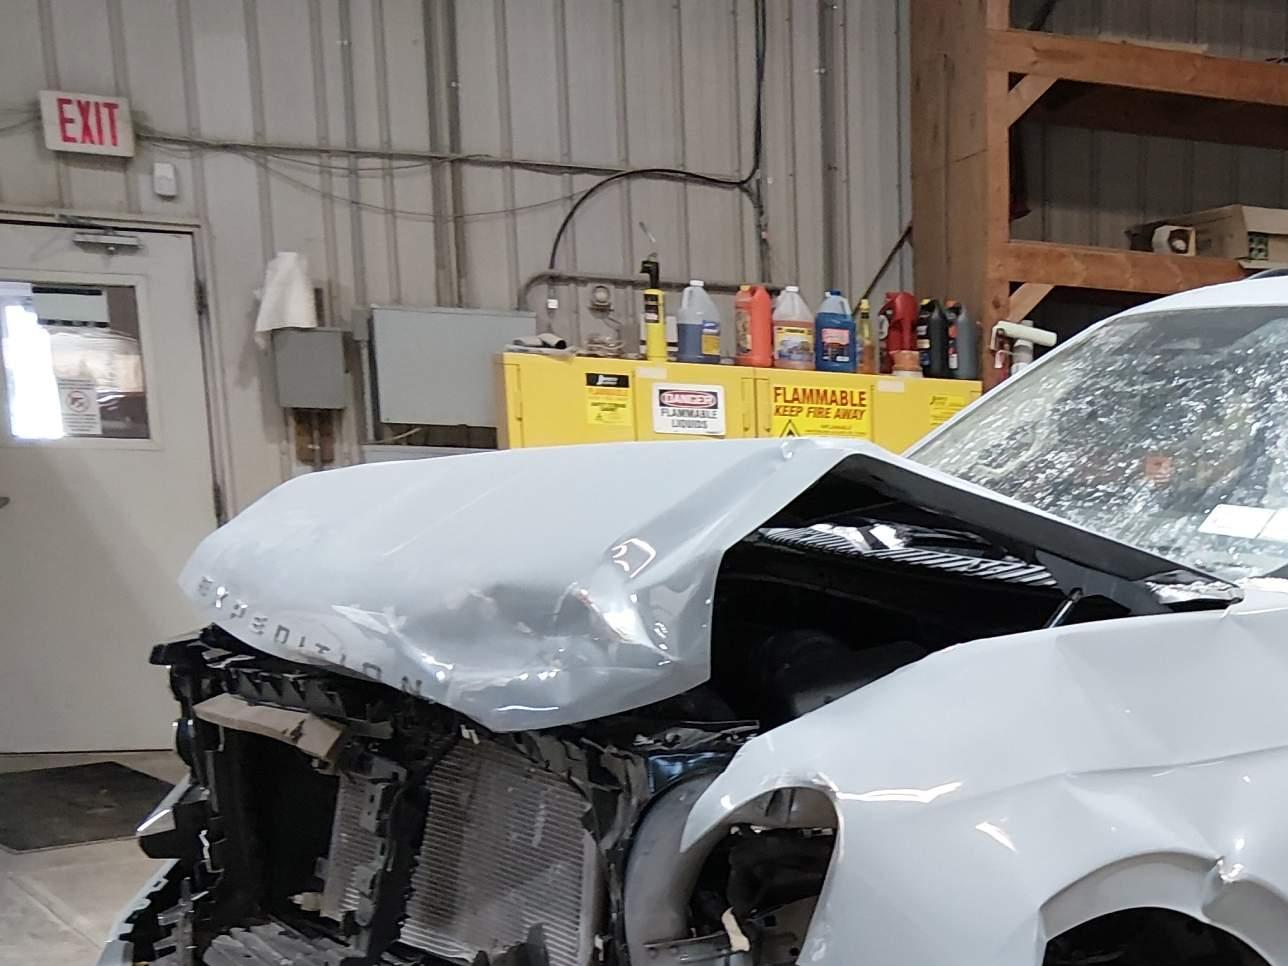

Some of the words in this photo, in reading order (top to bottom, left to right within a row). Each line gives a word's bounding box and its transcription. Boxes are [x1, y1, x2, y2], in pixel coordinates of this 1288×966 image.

[57, 98, 119, 146] EXIT
[773, 387, 867, 407] FLAMMABLE
[660, 408, 719, 419] FLAMMABLE
[774, 405, 803, 417] KEEP
[806, 407, 831, 419] FIRE
[834, 408, 865, 421] AWAY
